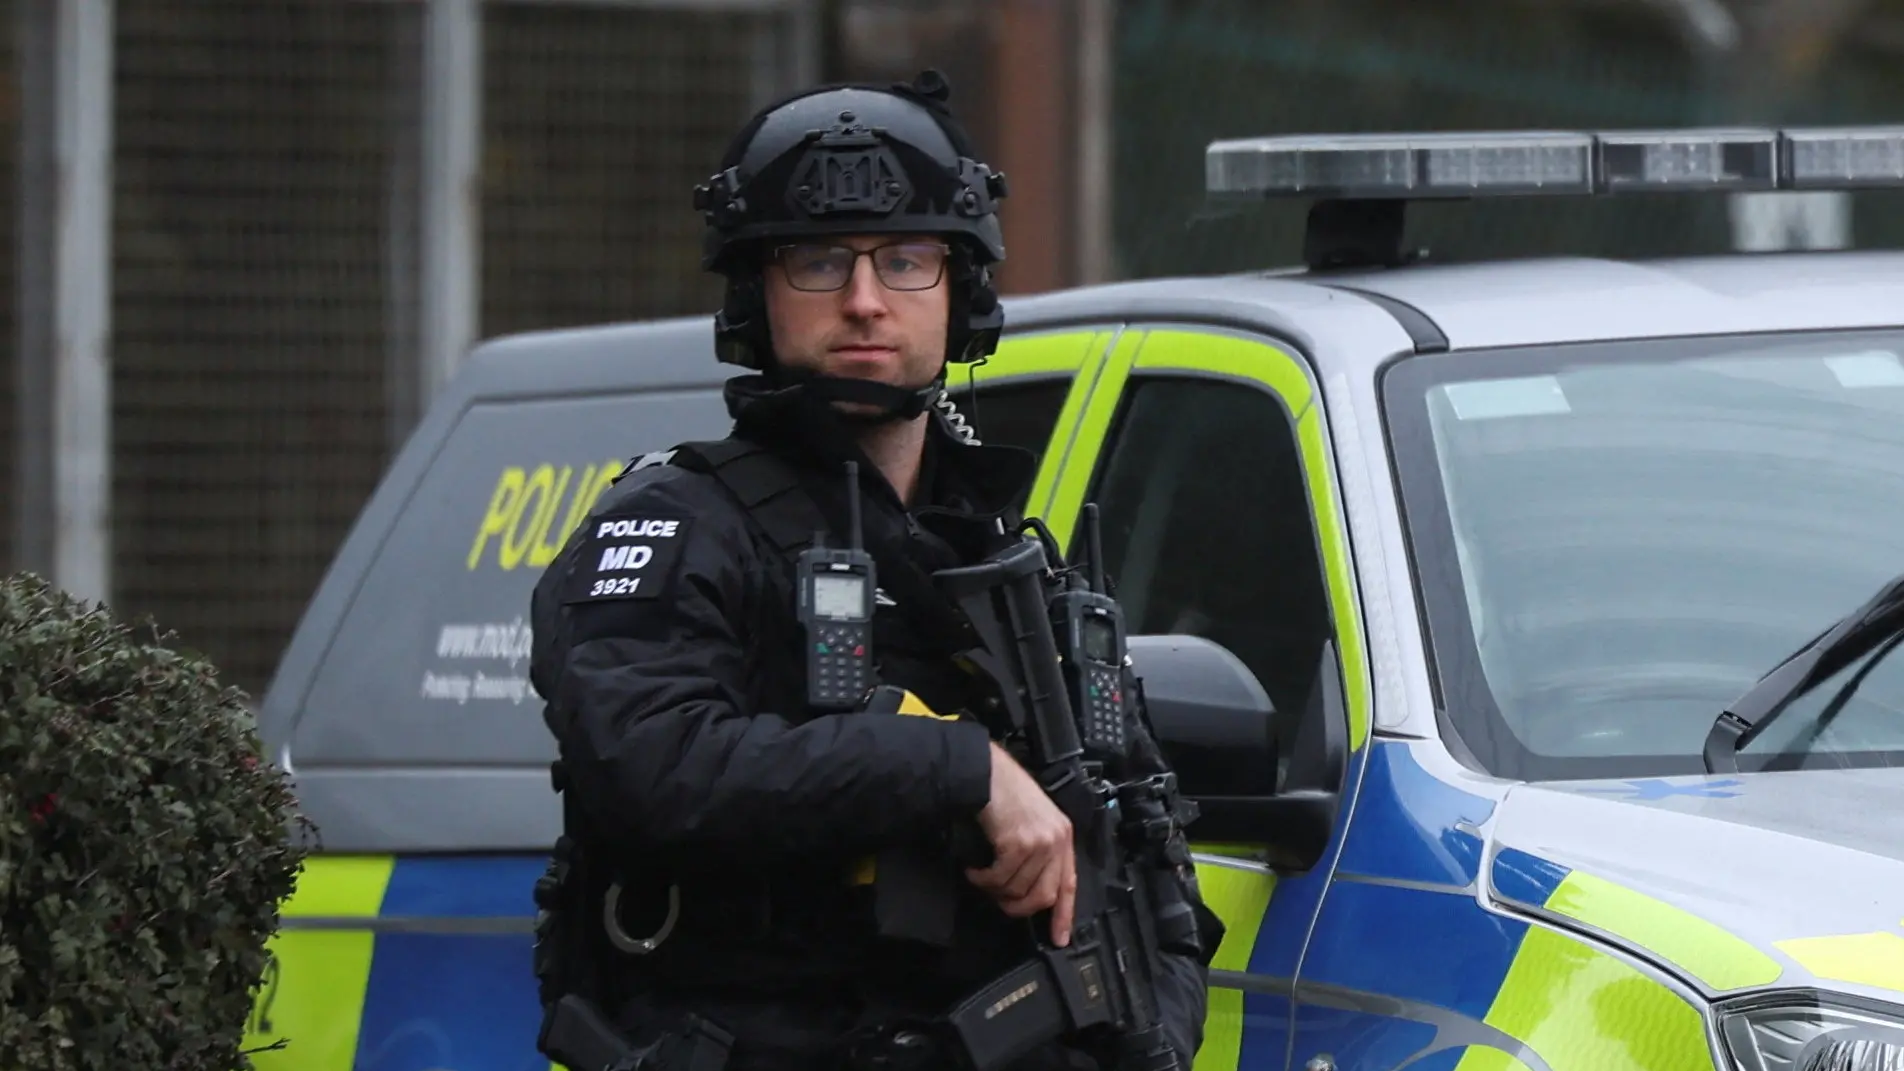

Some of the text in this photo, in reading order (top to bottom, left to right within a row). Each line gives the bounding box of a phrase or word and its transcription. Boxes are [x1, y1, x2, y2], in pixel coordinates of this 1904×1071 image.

[596, 519, 681, 539] POLICE
[597, 544, 654, 572] MD
[590, 576, 641, 597] 3921
